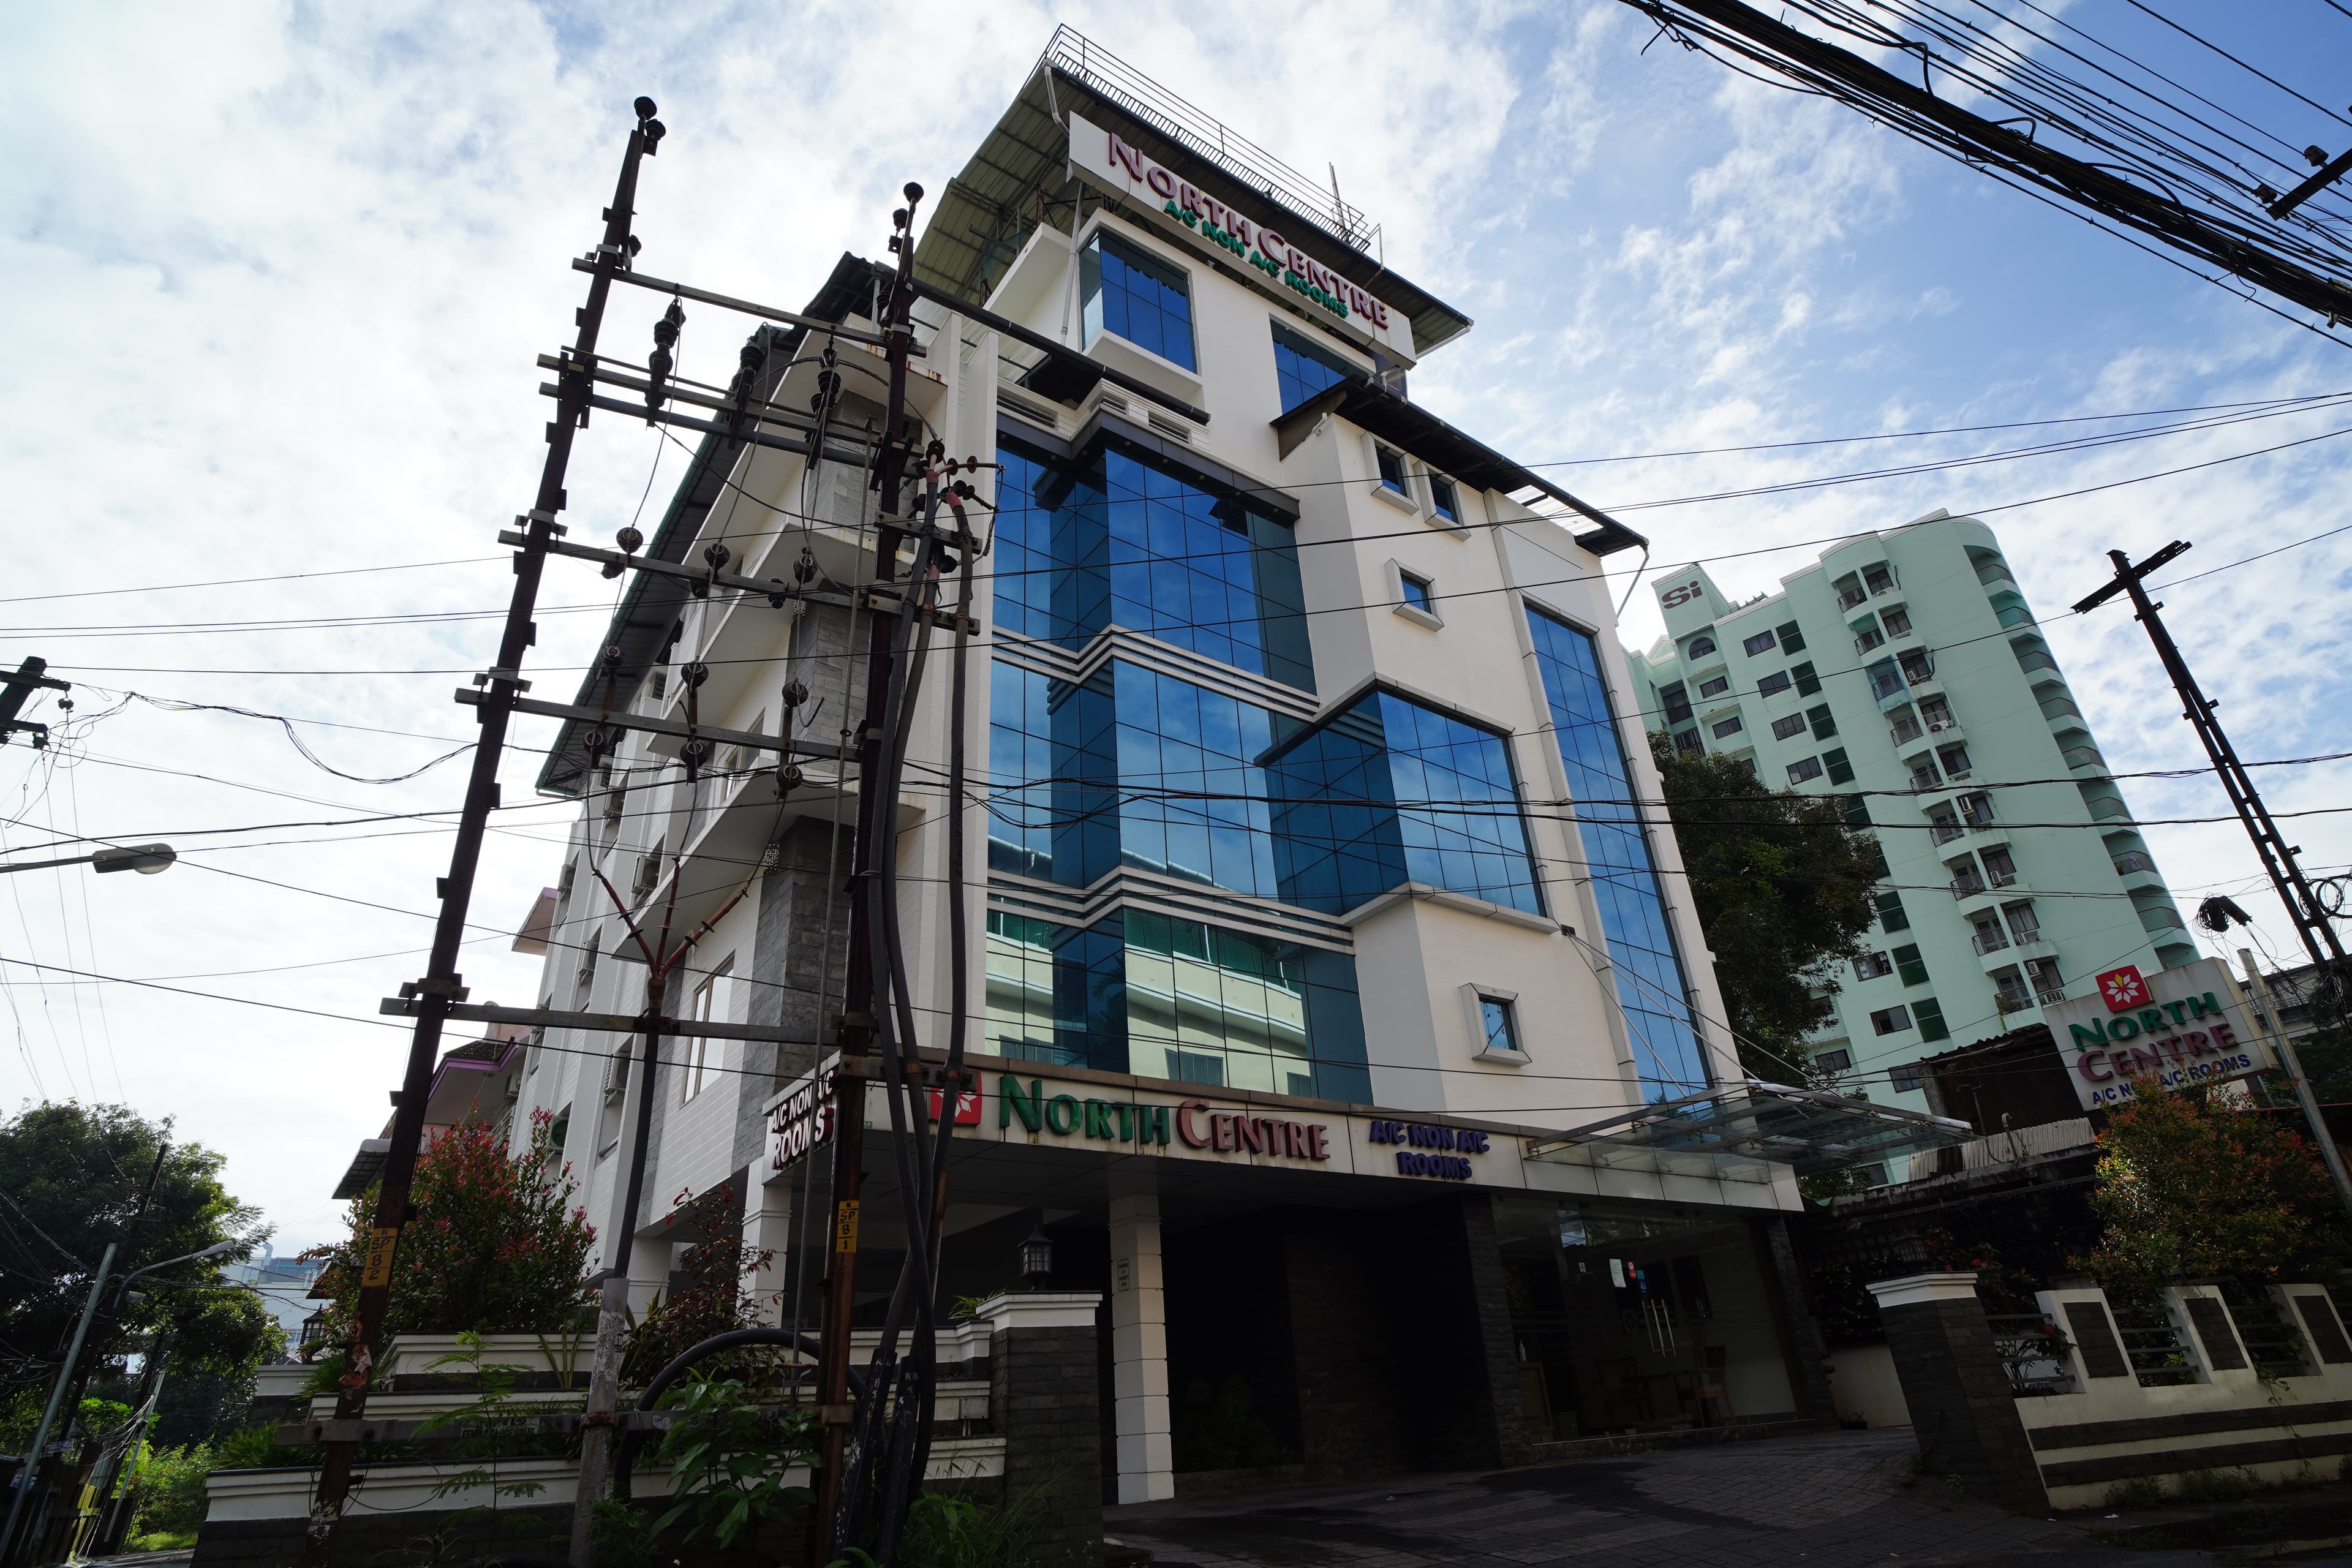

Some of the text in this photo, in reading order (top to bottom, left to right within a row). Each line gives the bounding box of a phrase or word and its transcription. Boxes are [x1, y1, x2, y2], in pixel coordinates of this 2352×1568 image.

[1109, 132, 1389, 330] NORTH CENTRE
[1164, 199, 1348, 318] A/C NON A/C ROOMS
[1661, 581, 1703, 609] Si
[2068, 992, 2223, 1052] NORTH
[2078, 1023, 2239, 1081] CENTRE
[772, 1103, 789, 1133] A/C
[789, 1084, 814, 1122] NON
[999, 1075, 1330, 1160] NORTH CENTRE
[1370, 1120, 1490, 1153] A/C NON A/C
[1396, 1151, 1472, 1180] ROOMS
[840, 1211, 856, 1221] SP
[842, 1224, 850, 1235] 8
[371, 1238, 390, 1250] SP
[843, 1239, 848, 1250] 1
[369, 1269, 379, 1280] 2
